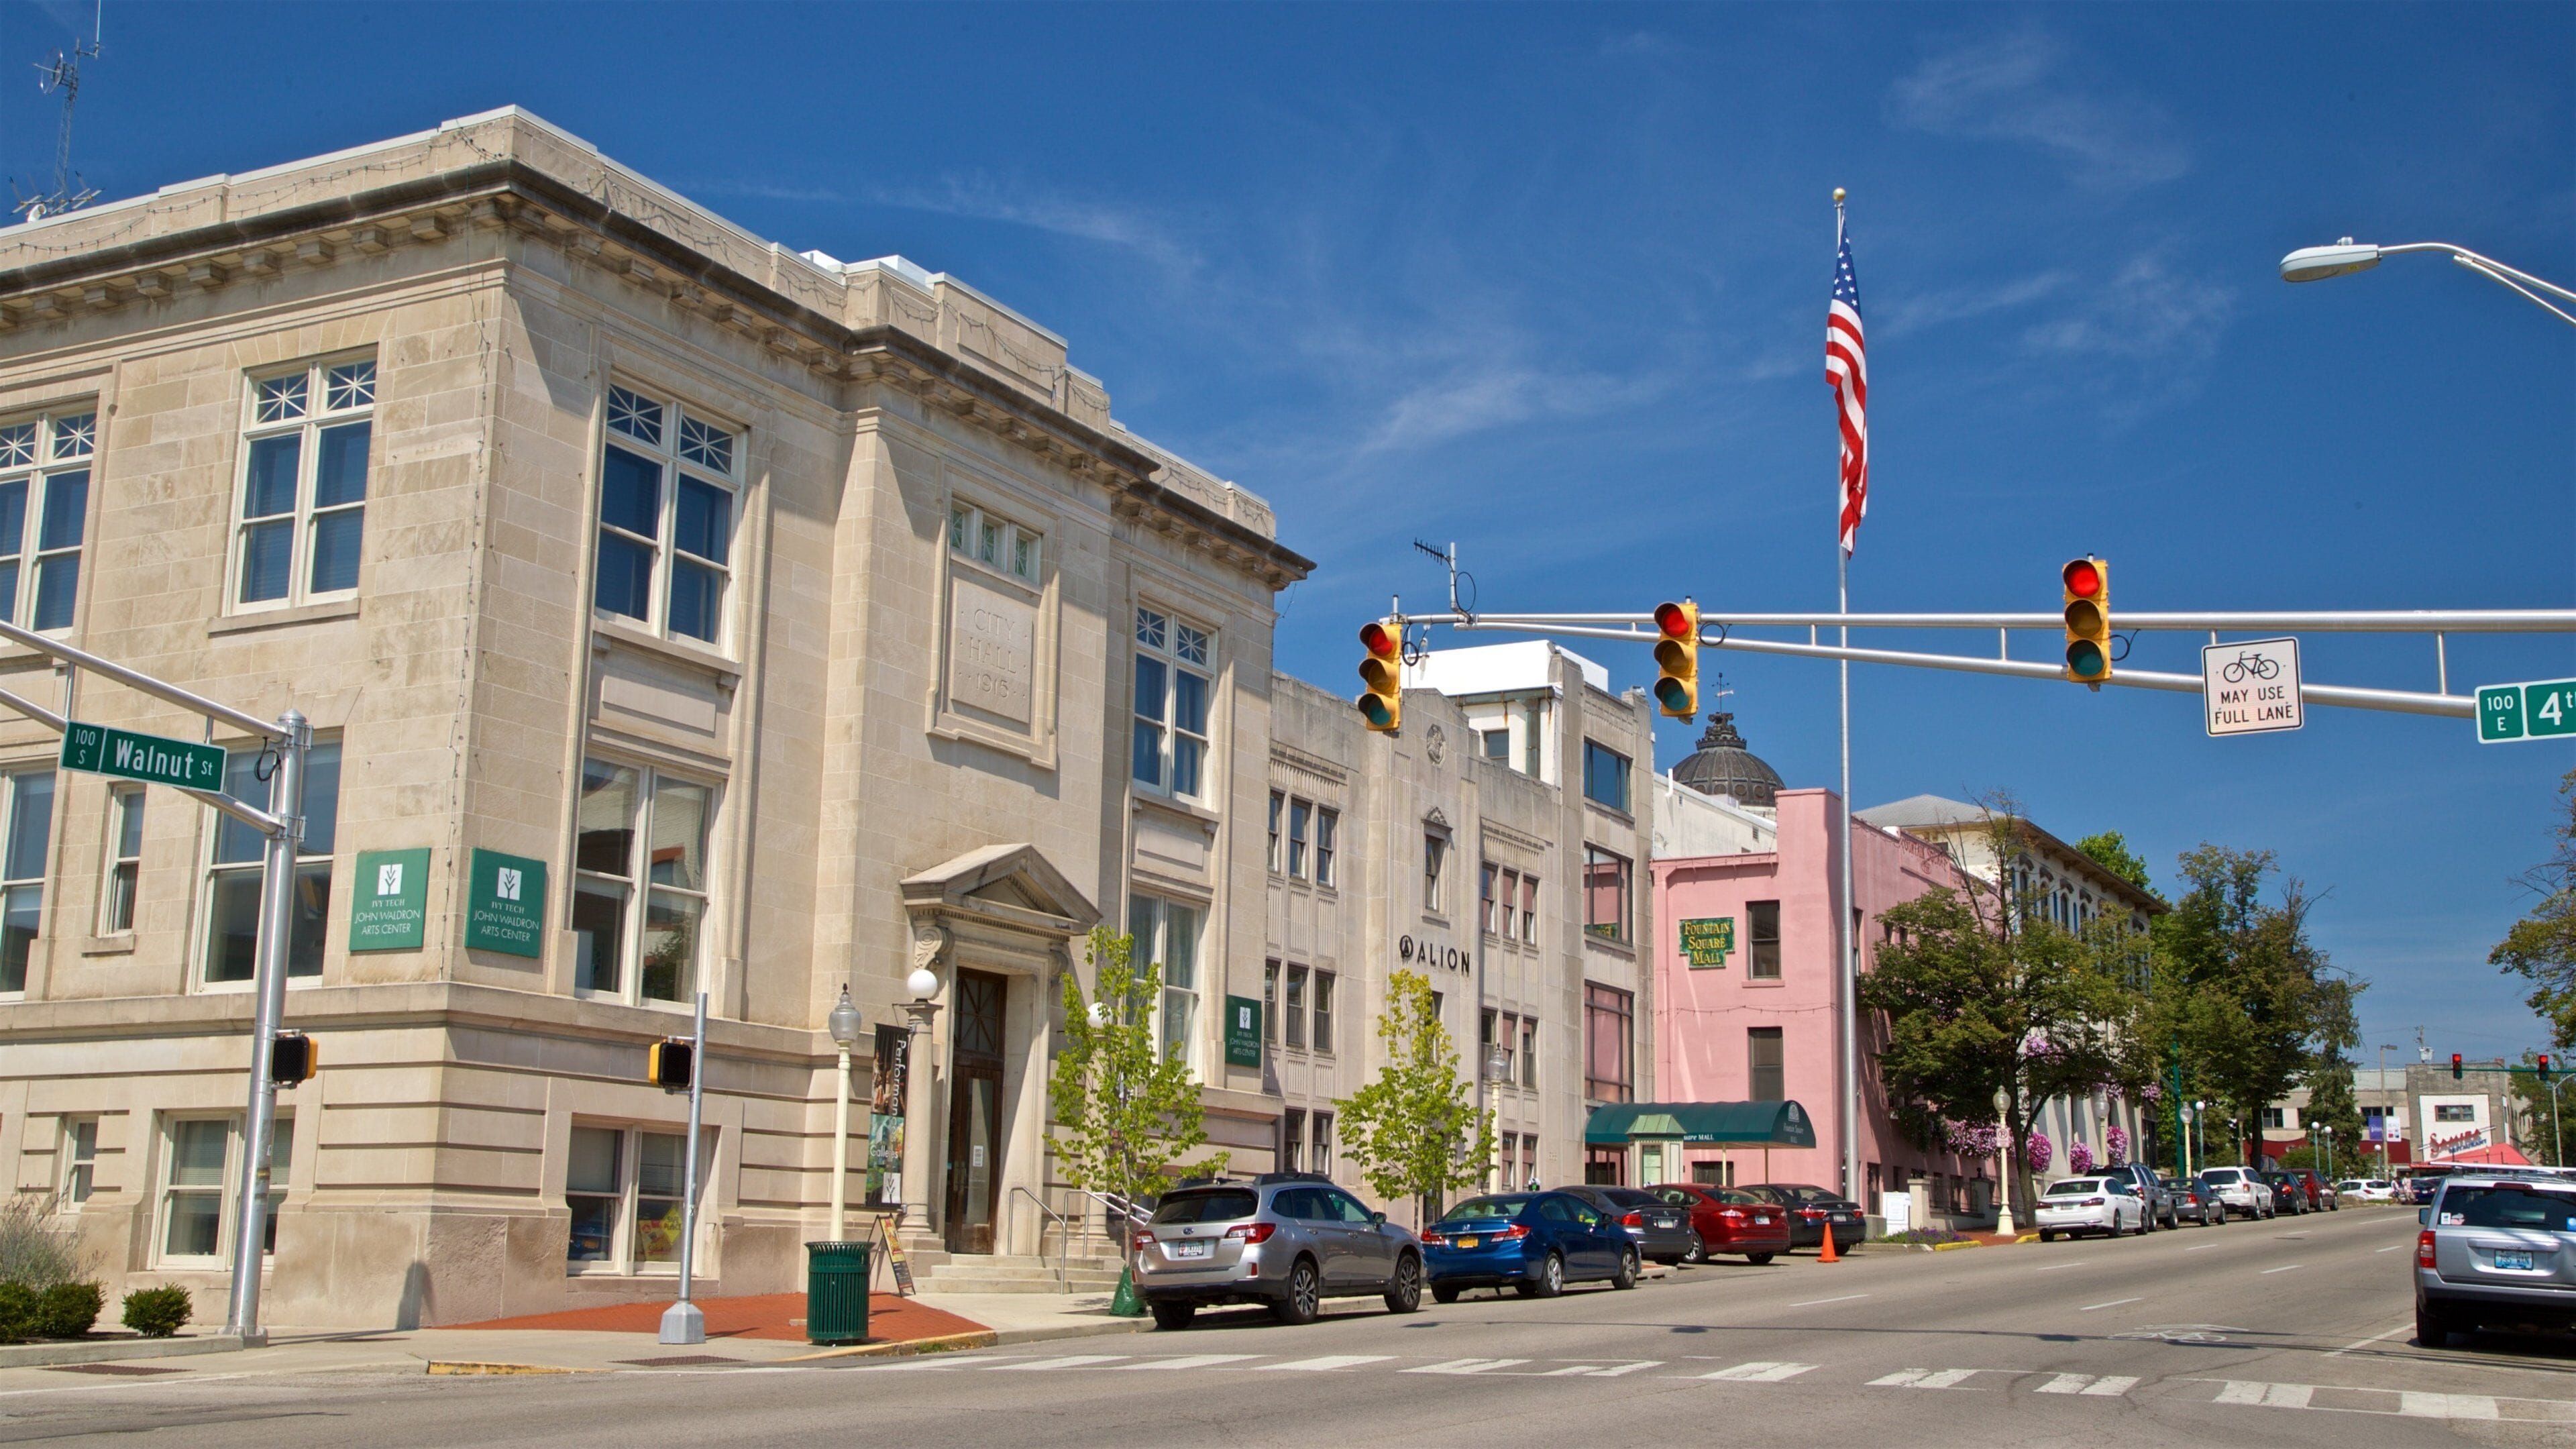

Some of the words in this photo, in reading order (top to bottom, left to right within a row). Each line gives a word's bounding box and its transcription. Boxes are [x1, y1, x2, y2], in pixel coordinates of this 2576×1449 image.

[974, 608, 1015, 641] CITY
[969, 637, 1016, 674] HALL
[976, 673, 1009, 698] 1915
[2220, 689, 2249, 704] MAY
[2258, 686, 2285, 701] USE
[2487, 695, 2514, 711] 100
[2215, 710, 2249, 724] FULL
[2258, 705, 2294, 720] LANE
[2538, 691, 2576, 725] 4t
[2497, 716, 2506, 731] E
[75, 729, 96, 746] 100
[78, 749, 86, 765] S
[115, 739, 194, 779] Walnut
[201, 760, 213, 775] St
[372, 900, 384, 908] IVY
[385, 898, 405, 907] TECH
[491, 901, 504, 910] IVY
[505, 904, 525, 914] TECH
[354, 912, 378, 924] JOHN
[380, 910, 421, 920] WALDRON
[474, 910, 499, 923] JOHN
[500, 914, 539, 930] WALDRON
[362, 924, 380, 935] ARTS
[381, 923, 411, 934] CENTER
[481, 925, 500, 937] ARTS
[500, 928, 531, 942] CENTER
[1417, 940, 1470, 975] ALION
[891, 1039, 906, 1142] Performances
